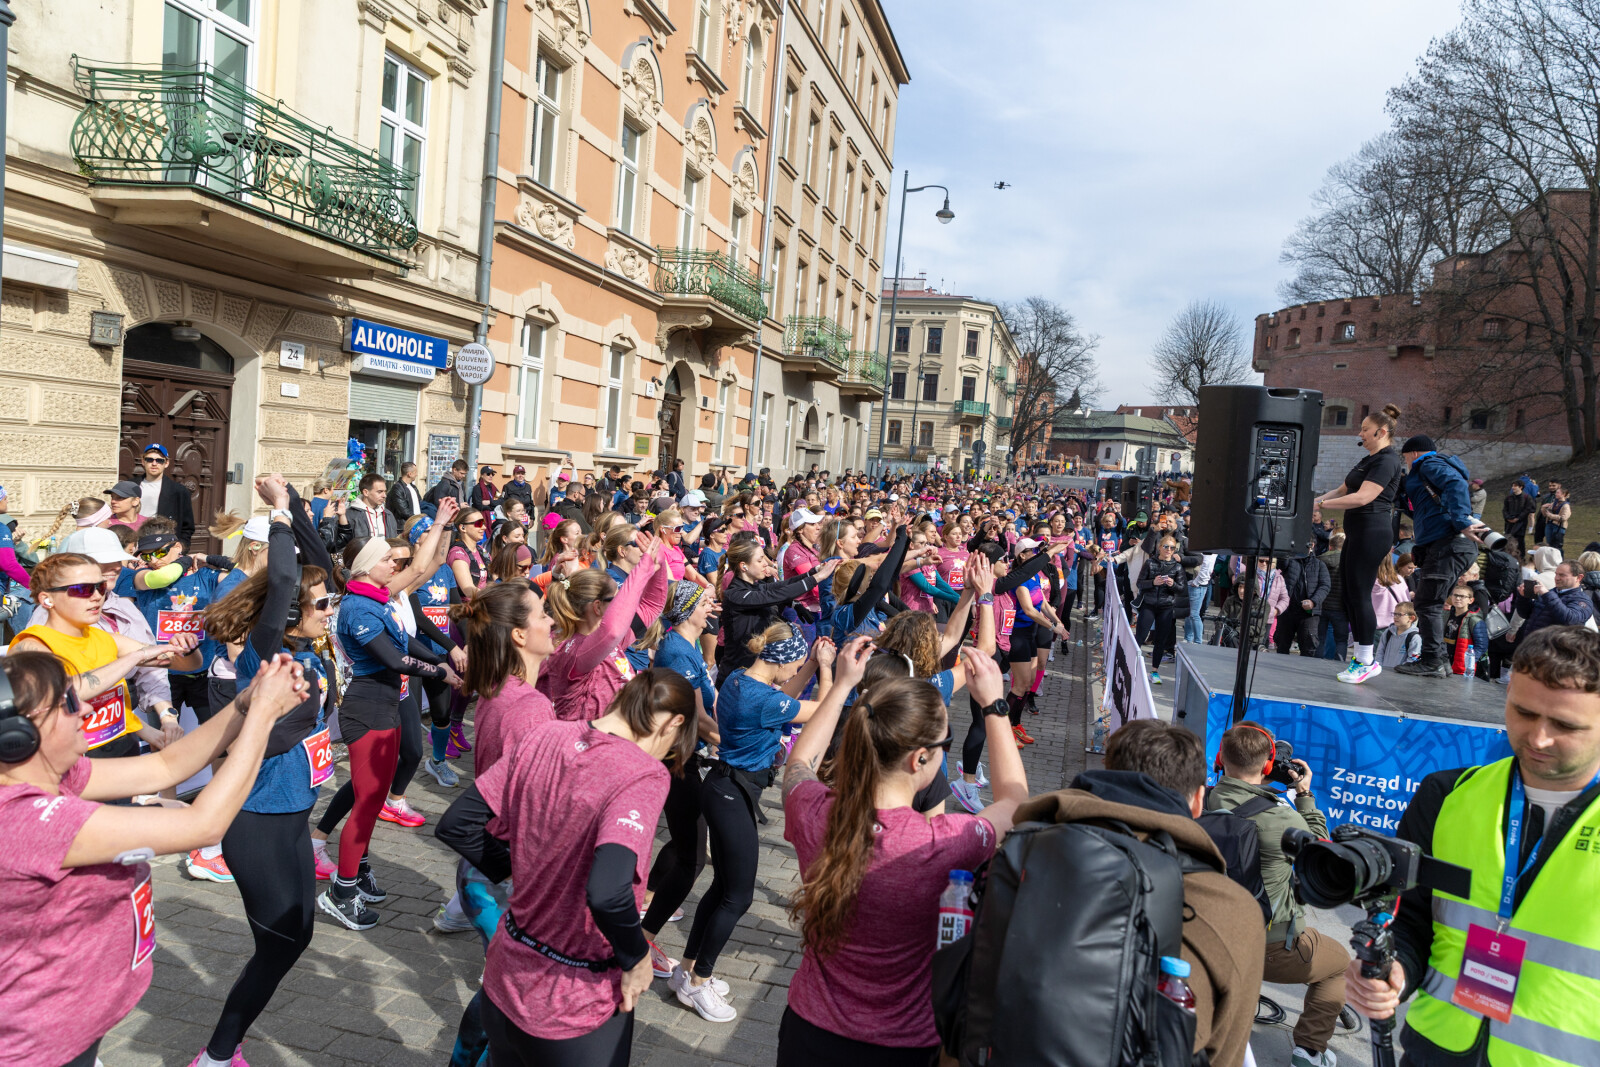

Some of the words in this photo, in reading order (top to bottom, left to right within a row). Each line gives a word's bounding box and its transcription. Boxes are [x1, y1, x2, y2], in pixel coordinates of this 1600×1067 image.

[354, 326, 434, 360] ALKOHOLE
[287, 348, 299, 360] 24
[461, 348, 485, 356] PAMIĄTKI
[457, 355, 489, 363] SOUVENIR
[369, 357, 398, 370] PAMIĄTKI
[402, 364, 433, 376] SOUVENIRS
[456, 364, 488, 373] ALKOHOLE
[460, 372, 483, 380] NAPOJE
[164, 620, 200, 632] 2862
[86, 700, 122, 730] 2270
[316, 743, 333, 768] 26
[1332, 766, 1400, 793] Zarząd
[1328, 807, 1344, 819] w
